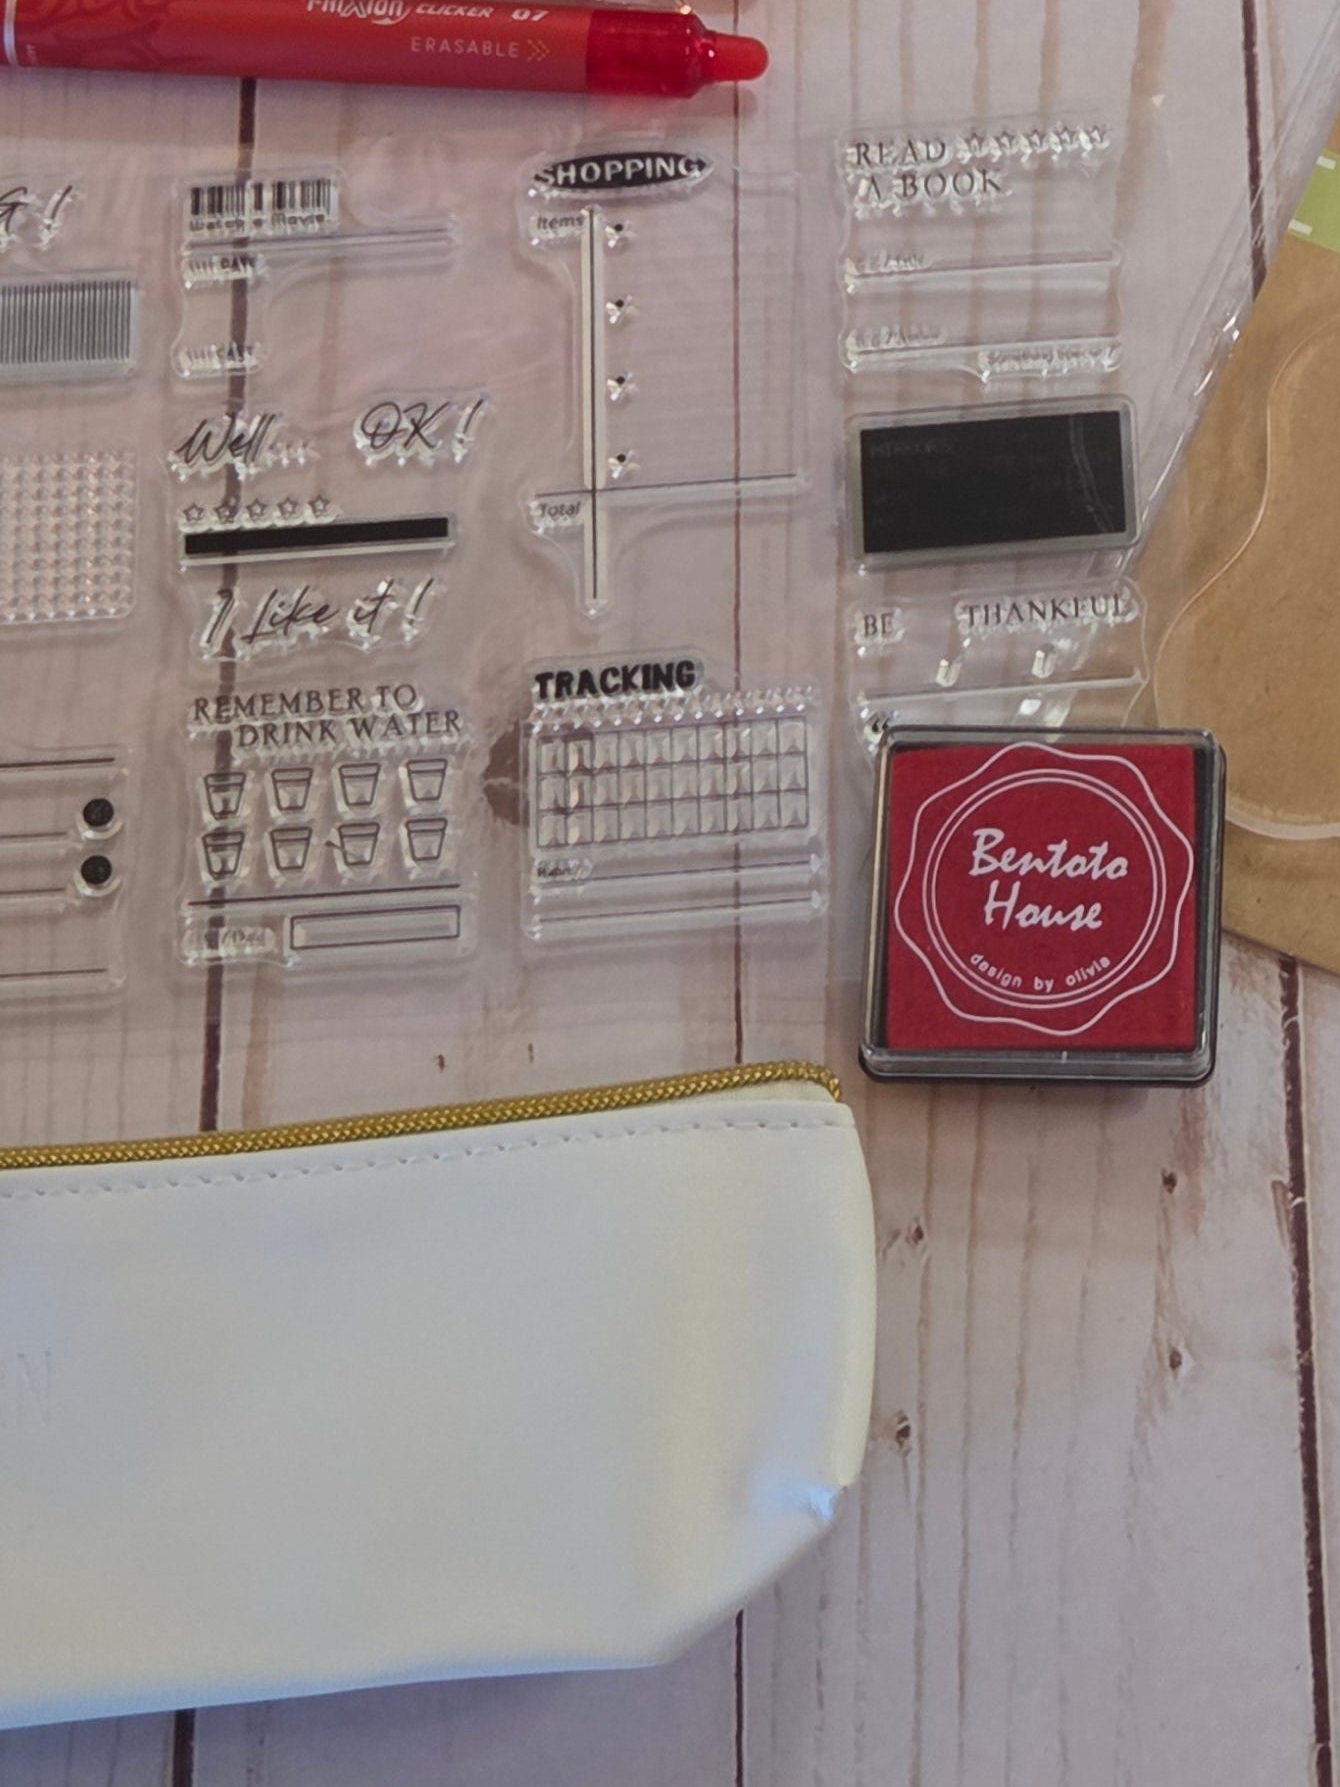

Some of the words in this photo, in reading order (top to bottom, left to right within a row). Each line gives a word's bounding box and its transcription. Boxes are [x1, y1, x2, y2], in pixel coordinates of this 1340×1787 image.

[415, 3, 494, 18] CLICKER
[510, 9, 550, 21] 07
[410, 36, 521, 58] ERASABLE
[534, 158, 700, 186] SHOPPING
[855, 139, 946, 167] READ
[901, 168, 1002, 199] BOOK
[864, 613, 895, 636] BE
[964, 593, 1125, 626] THANKFUL
[535, 660, 696, 700] TRACKING
[193, 685, 364, 722] REMEMBER
[376, 684, 418, 708] TO
[238, 720, 337, 748] DRINK
[348, 710, 462, 739] WATER
[969, 828, 1129, 880] Bentoto
[984, 879, 1103, 931] House
[970, 953, 1023, 988] design
[1033, 976, 1054, 993] by
[1065, 956, 1111, 986] olivia
